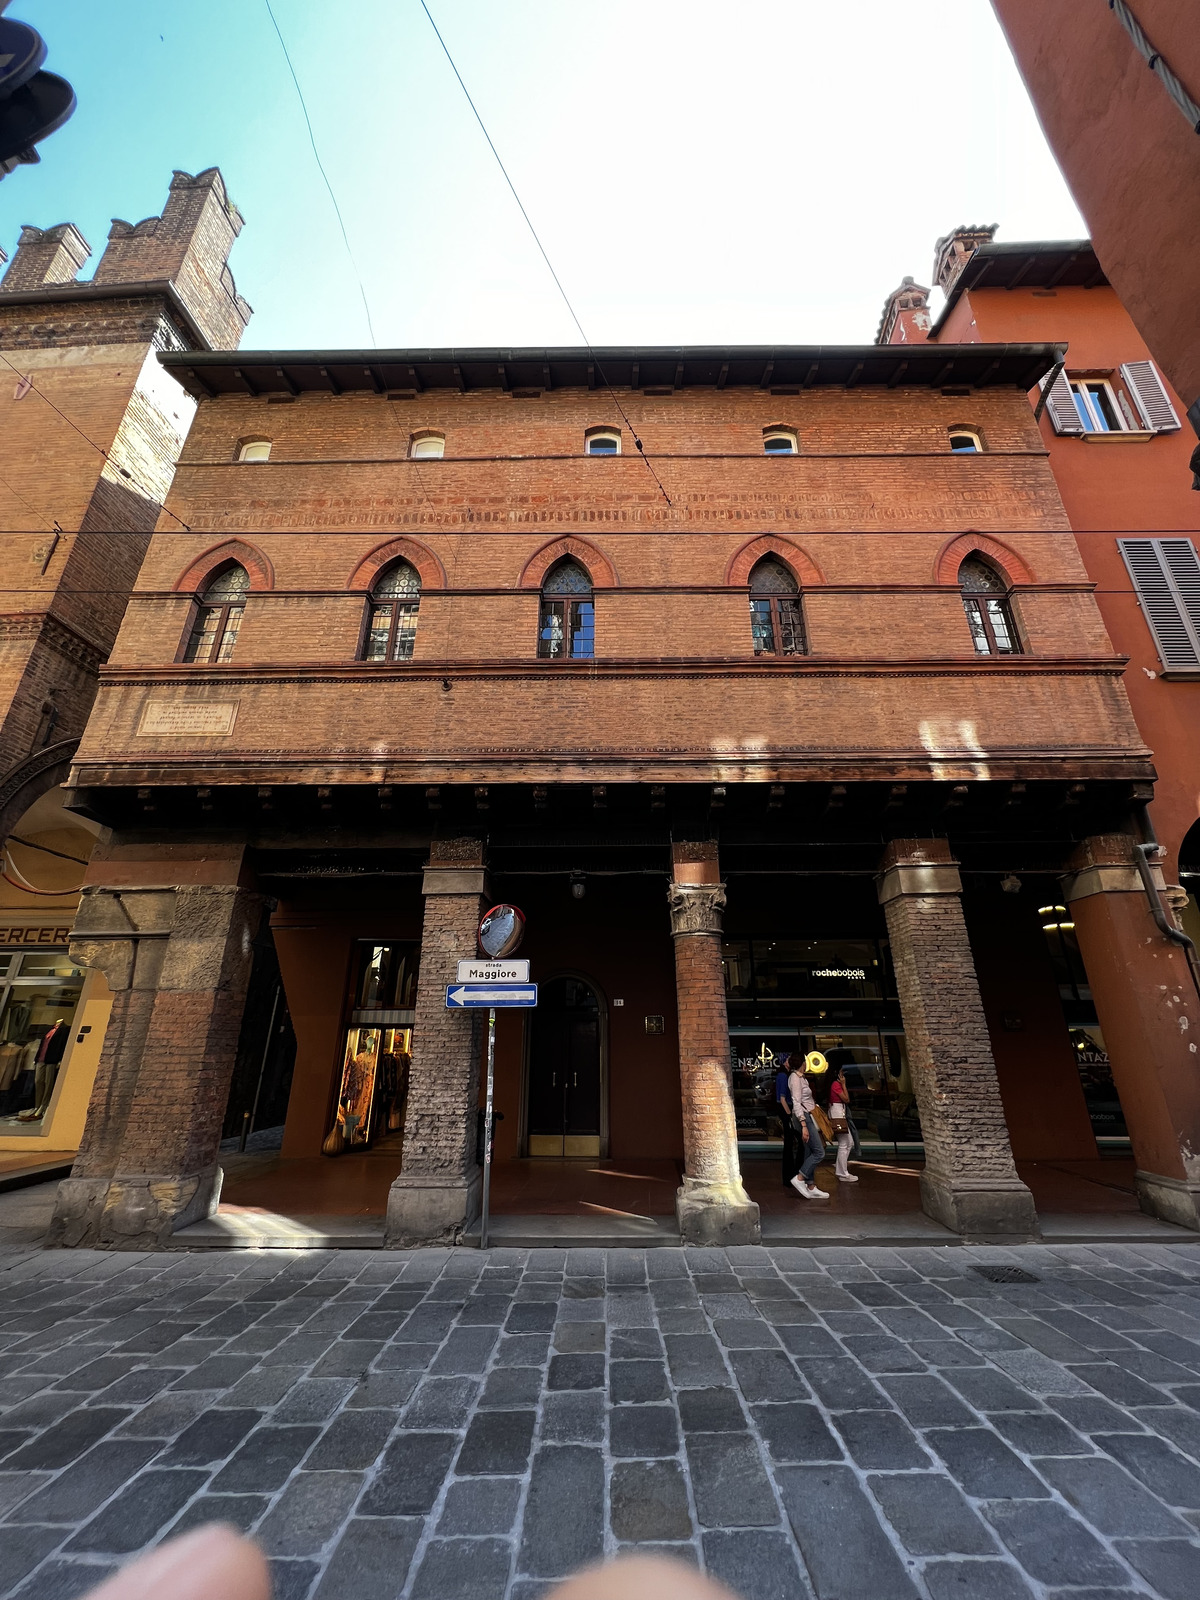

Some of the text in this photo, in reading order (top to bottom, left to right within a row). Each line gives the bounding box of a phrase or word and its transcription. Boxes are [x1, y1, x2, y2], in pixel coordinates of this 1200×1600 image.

[0, 927, 71, 943] ERCER
[469, 969, 517, 980] Maggiore
[811, 968, 865, 977] rochebobois
